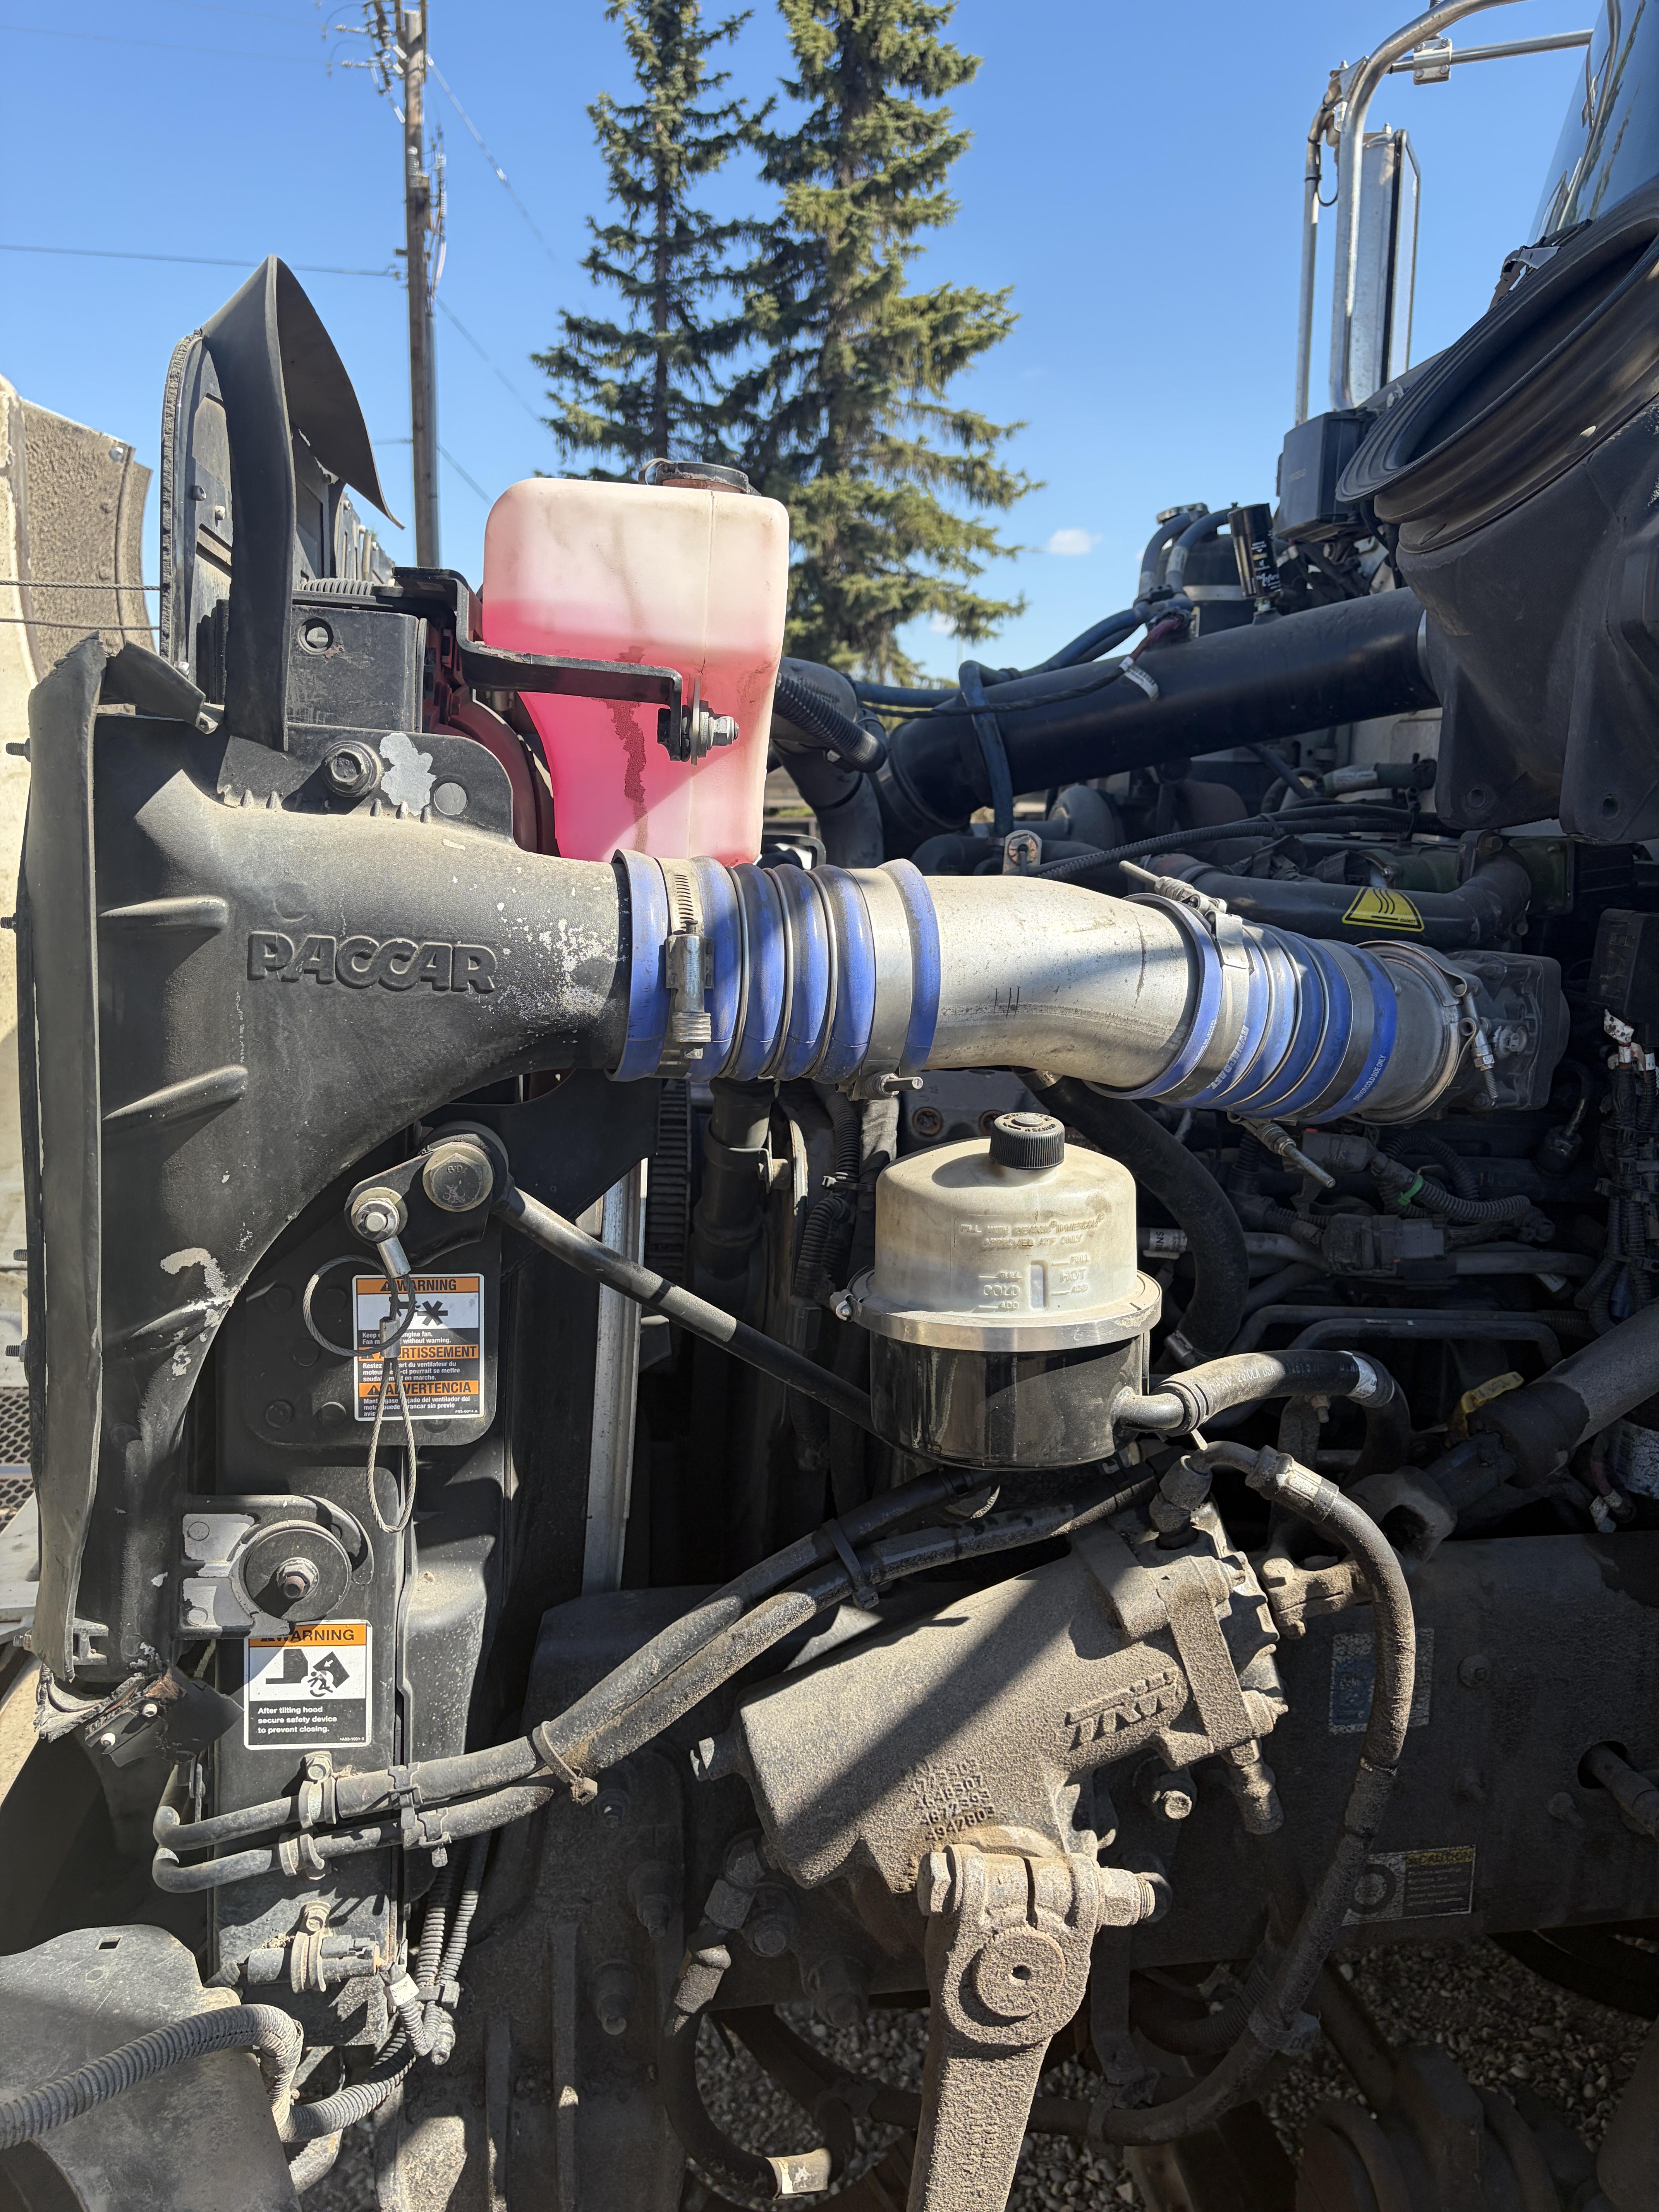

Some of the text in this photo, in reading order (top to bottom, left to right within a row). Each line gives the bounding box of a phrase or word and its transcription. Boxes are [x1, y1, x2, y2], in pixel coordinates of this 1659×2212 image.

[247, 930, 497, 993] PACCAR
[1376, 1055, 1386, 1067] ONLY
[1371, 1067, 1382, 1077] SIDE
[960, 1224, 982, 1233] FILL
[987, 1224, 1010, 1234] WITH
[983, 1234, 1083, 1247] APPROVED ATF ONLY
[1070, 1254, 1089, 1264] FULL
[1000, 1271, 1022, 1279] FULL
[1060, 1269, 1086, 1283] HOT
[983, 1284, 1021, 1297] COLD
[279, 1706, 301, 1714] tilting
[268, 1726, 298, 1735] prevent
